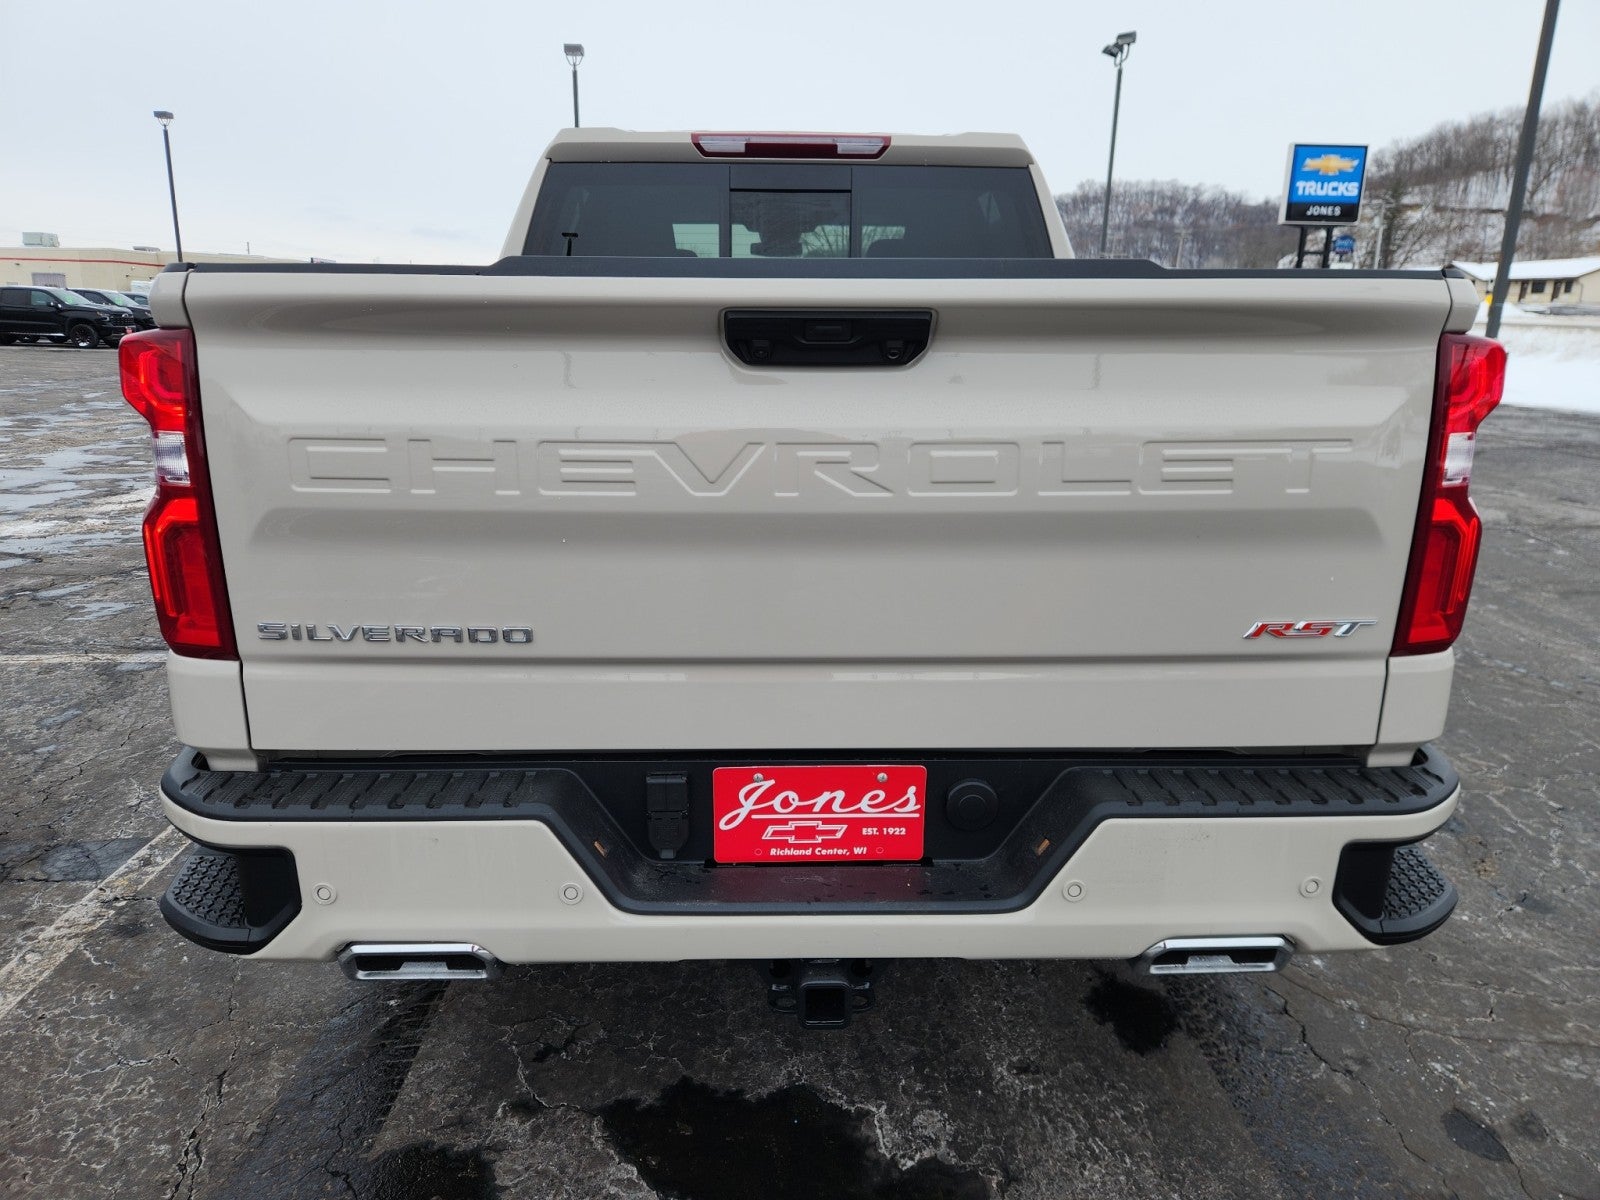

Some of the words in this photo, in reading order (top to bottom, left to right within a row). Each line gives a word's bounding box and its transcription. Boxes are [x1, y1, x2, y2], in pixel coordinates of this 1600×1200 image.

[1296, 180, 1359, 196] TRUCKS
[1306, 205, 1341, 216] JONES
[287, 437, 1354, 497] CHEVROLET
[257, 622, 534, 643] SILVERADO
[1243, 620, 1377, 639] RST
[719, 779, 921, 831] Jones
[862, 827, 879, 836] EST.
[882, 827, 906, 836] 1922
[770, 847, 812, 856] Richland
[815, 847, 850, 857] Center,
[853, 846, 867, 855] WI
